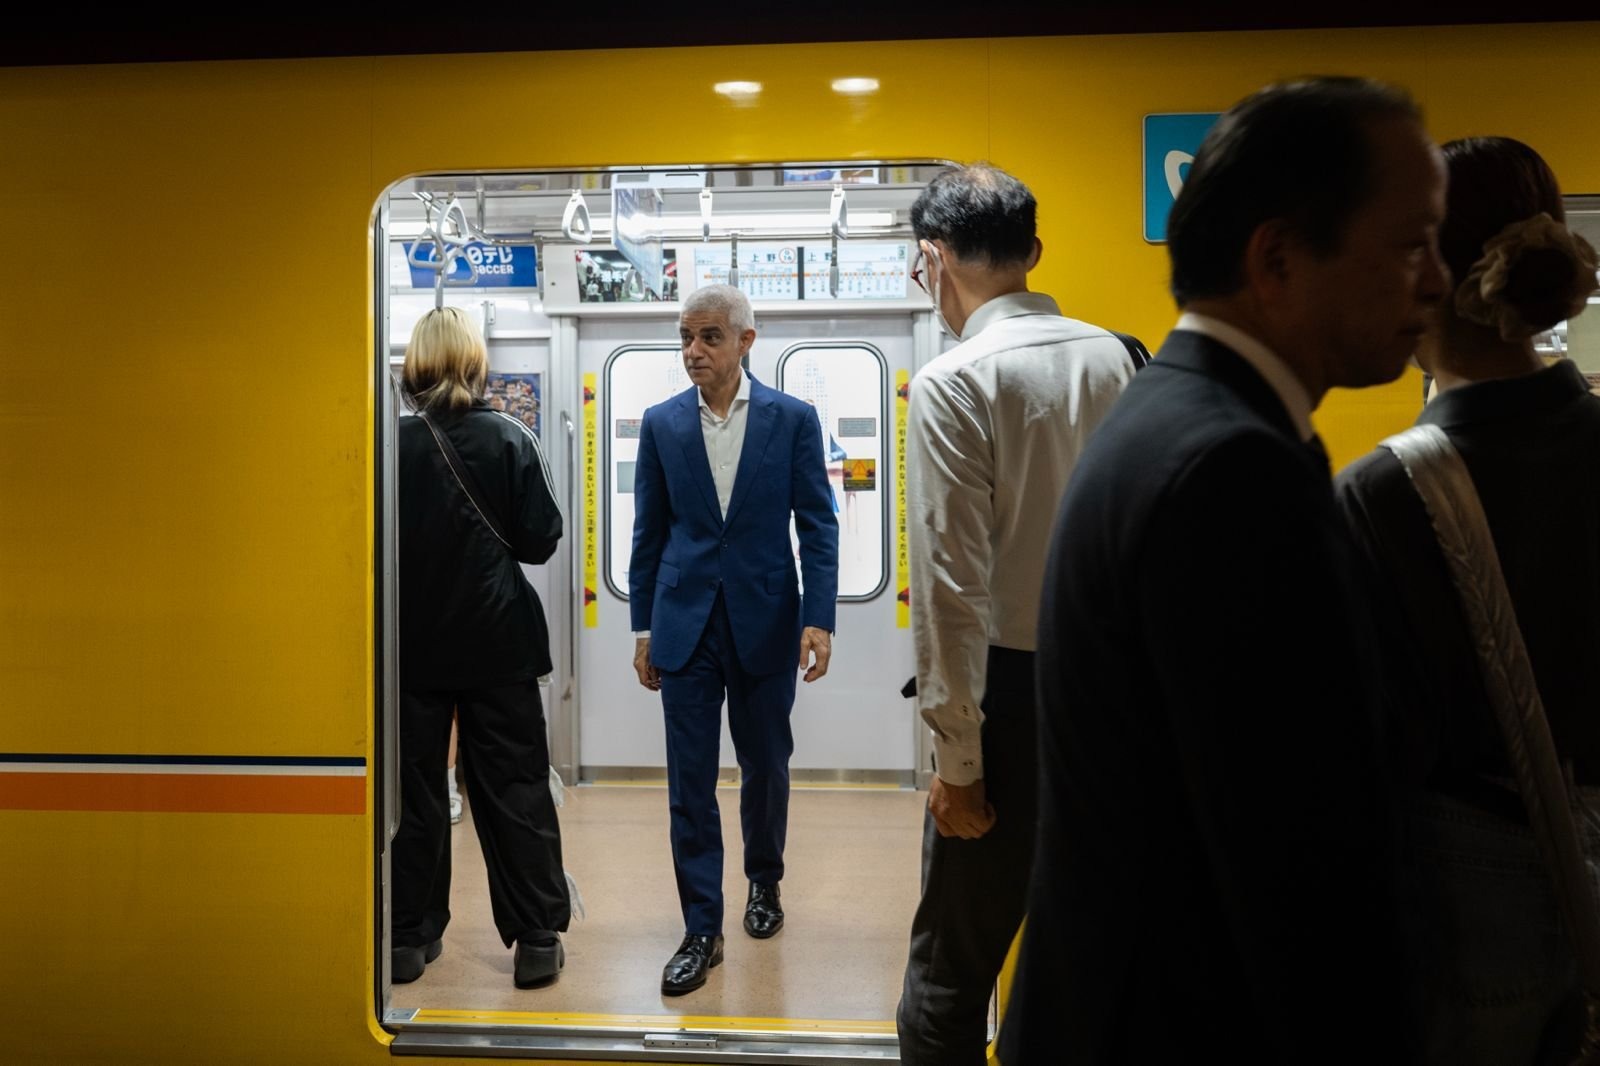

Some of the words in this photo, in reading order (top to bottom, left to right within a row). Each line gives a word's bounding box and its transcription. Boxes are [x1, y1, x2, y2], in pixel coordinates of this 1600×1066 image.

[474, 265, 514, 275] SOCCER
[586, 431, 595, 506] 引き込まれないよう
[586, 510, 595, 567] ご注意ください
[898, 509, 907, 567] ご注意ください
